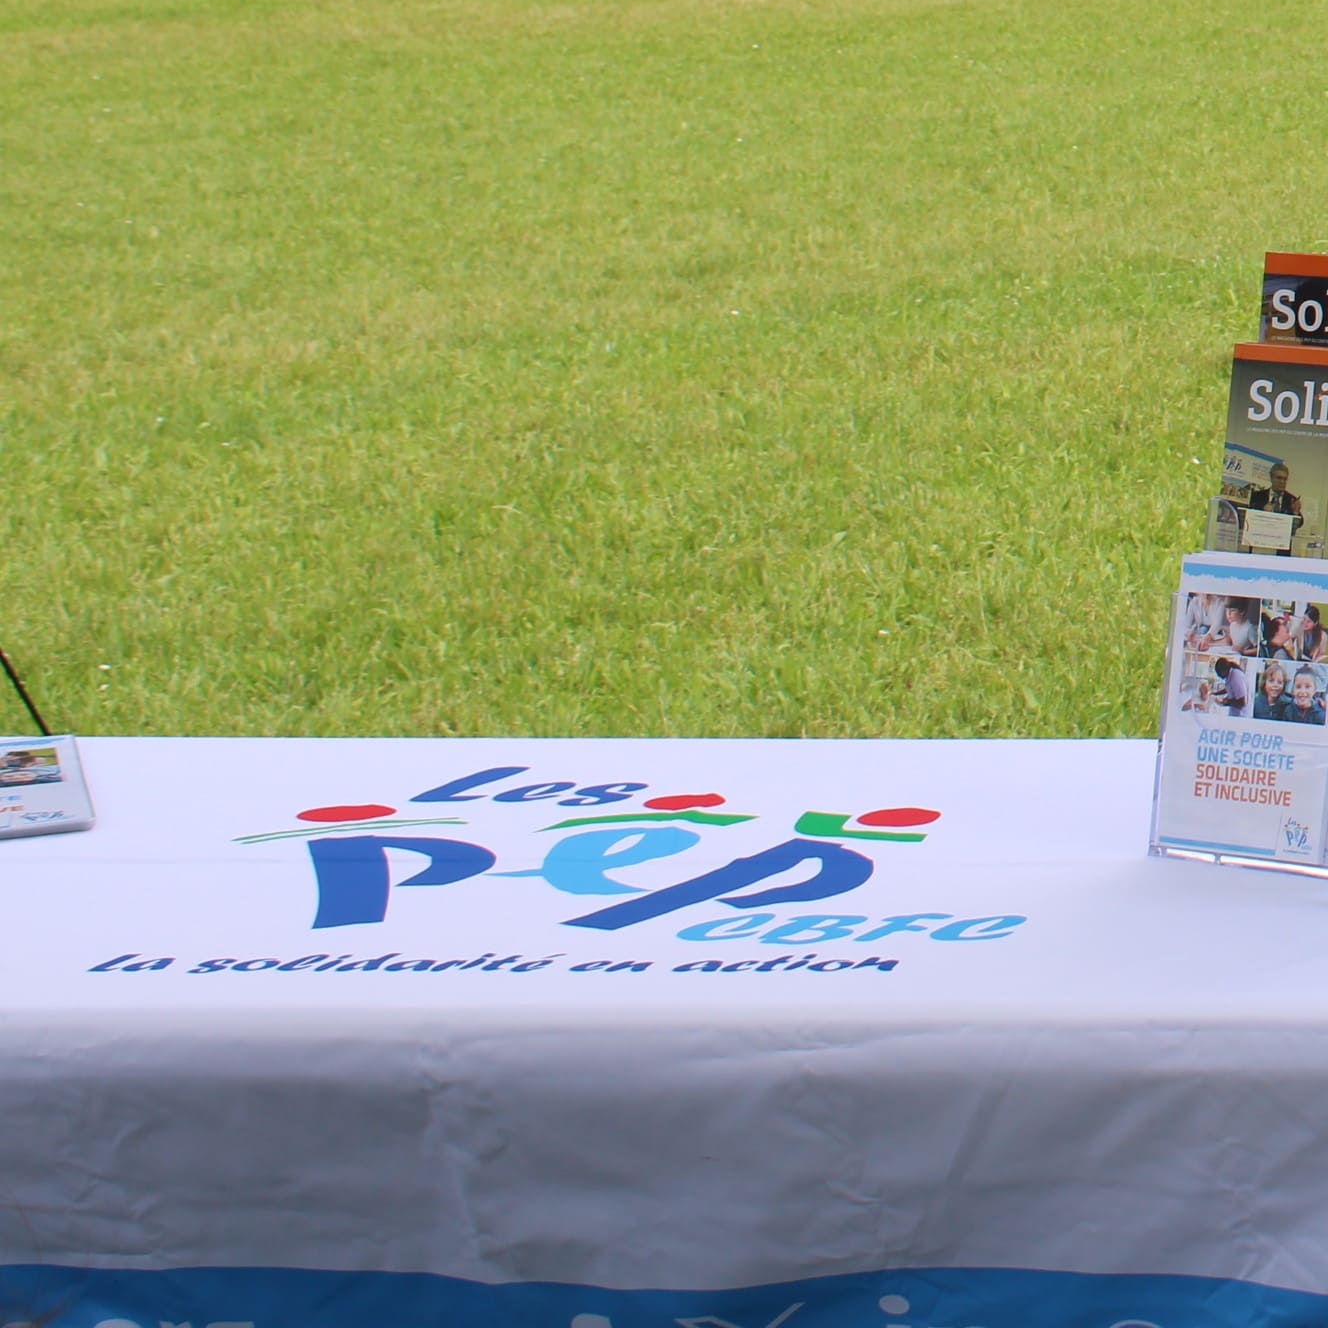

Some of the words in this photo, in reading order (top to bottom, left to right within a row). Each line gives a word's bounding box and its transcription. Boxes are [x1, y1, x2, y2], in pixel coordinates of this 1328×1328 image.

[1198, 728, 1236, 746] AGIR
[1240, 732, 1284, 751] POUR
[1197, 746, 1229, 764] UNE
[1232, 749, 1295, 771] SOCIETE
[408, 766, 649, 807] Les
[1195, 763, 1277, 787] SOLIDAIRE
[1194, 781, 1212, 798] ET
[1215, 783, 1292, 807] INCLUSIVE
[676, 913, 1028, 945] CBFC
[88, 953, 175, 973] La
[187, 949, 567, 974] solidarité
[570, 957, 655, 973] en
[671, 953, 900, 973] action
